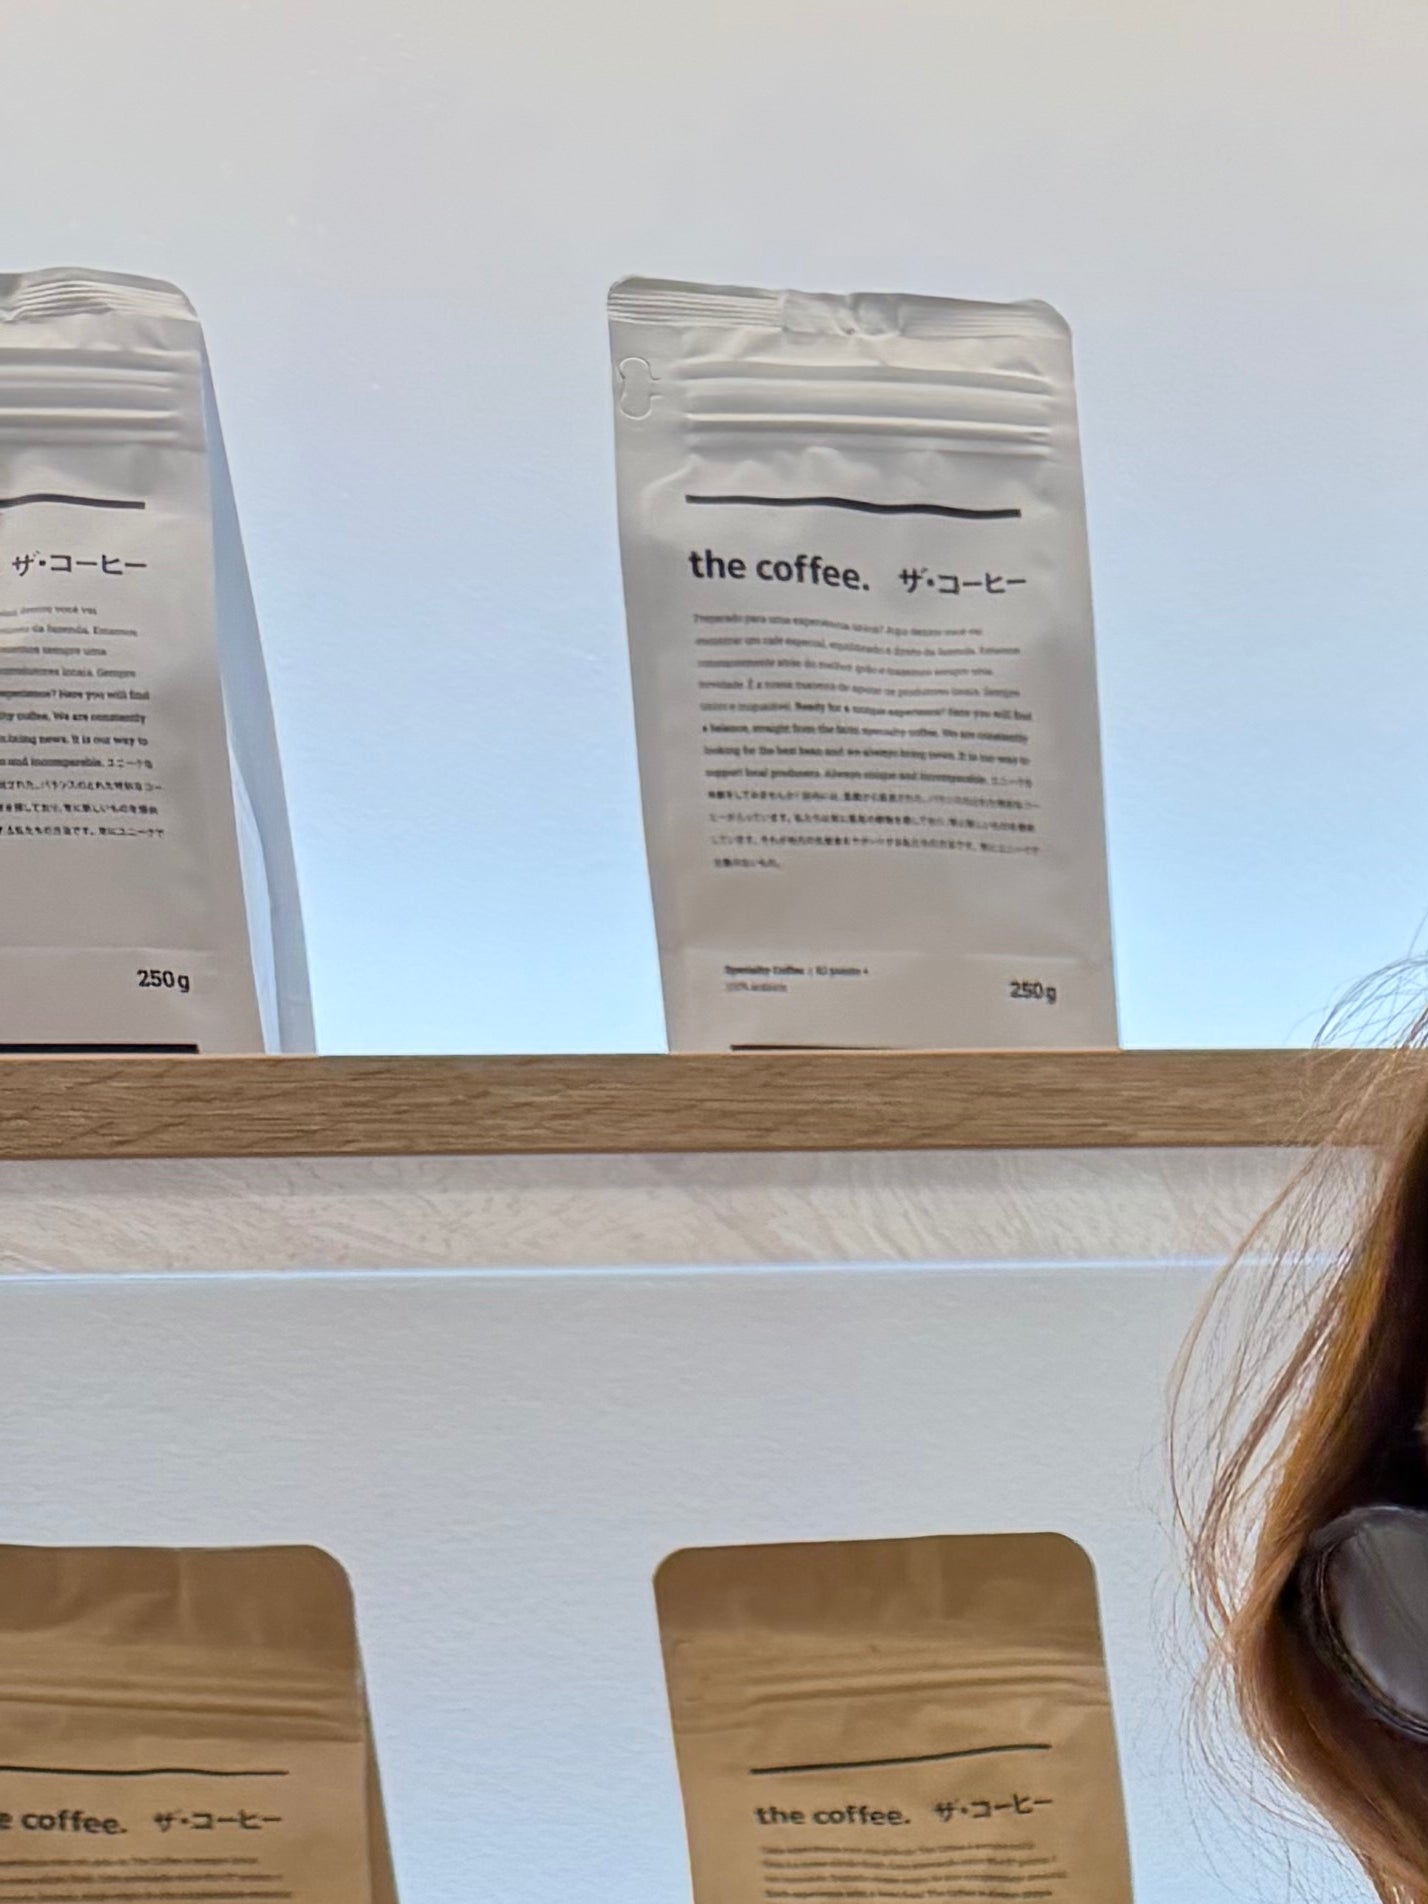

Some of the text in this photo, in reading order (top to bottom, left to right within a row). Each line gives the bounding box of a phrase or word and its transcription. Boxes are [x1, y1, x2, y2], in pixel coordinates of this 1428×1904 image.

[688, 548, 870, 591] the coffee.
[20, 1808, 128, 1836] coffee.
[753, 1804, 911, 1826] the coffee.
